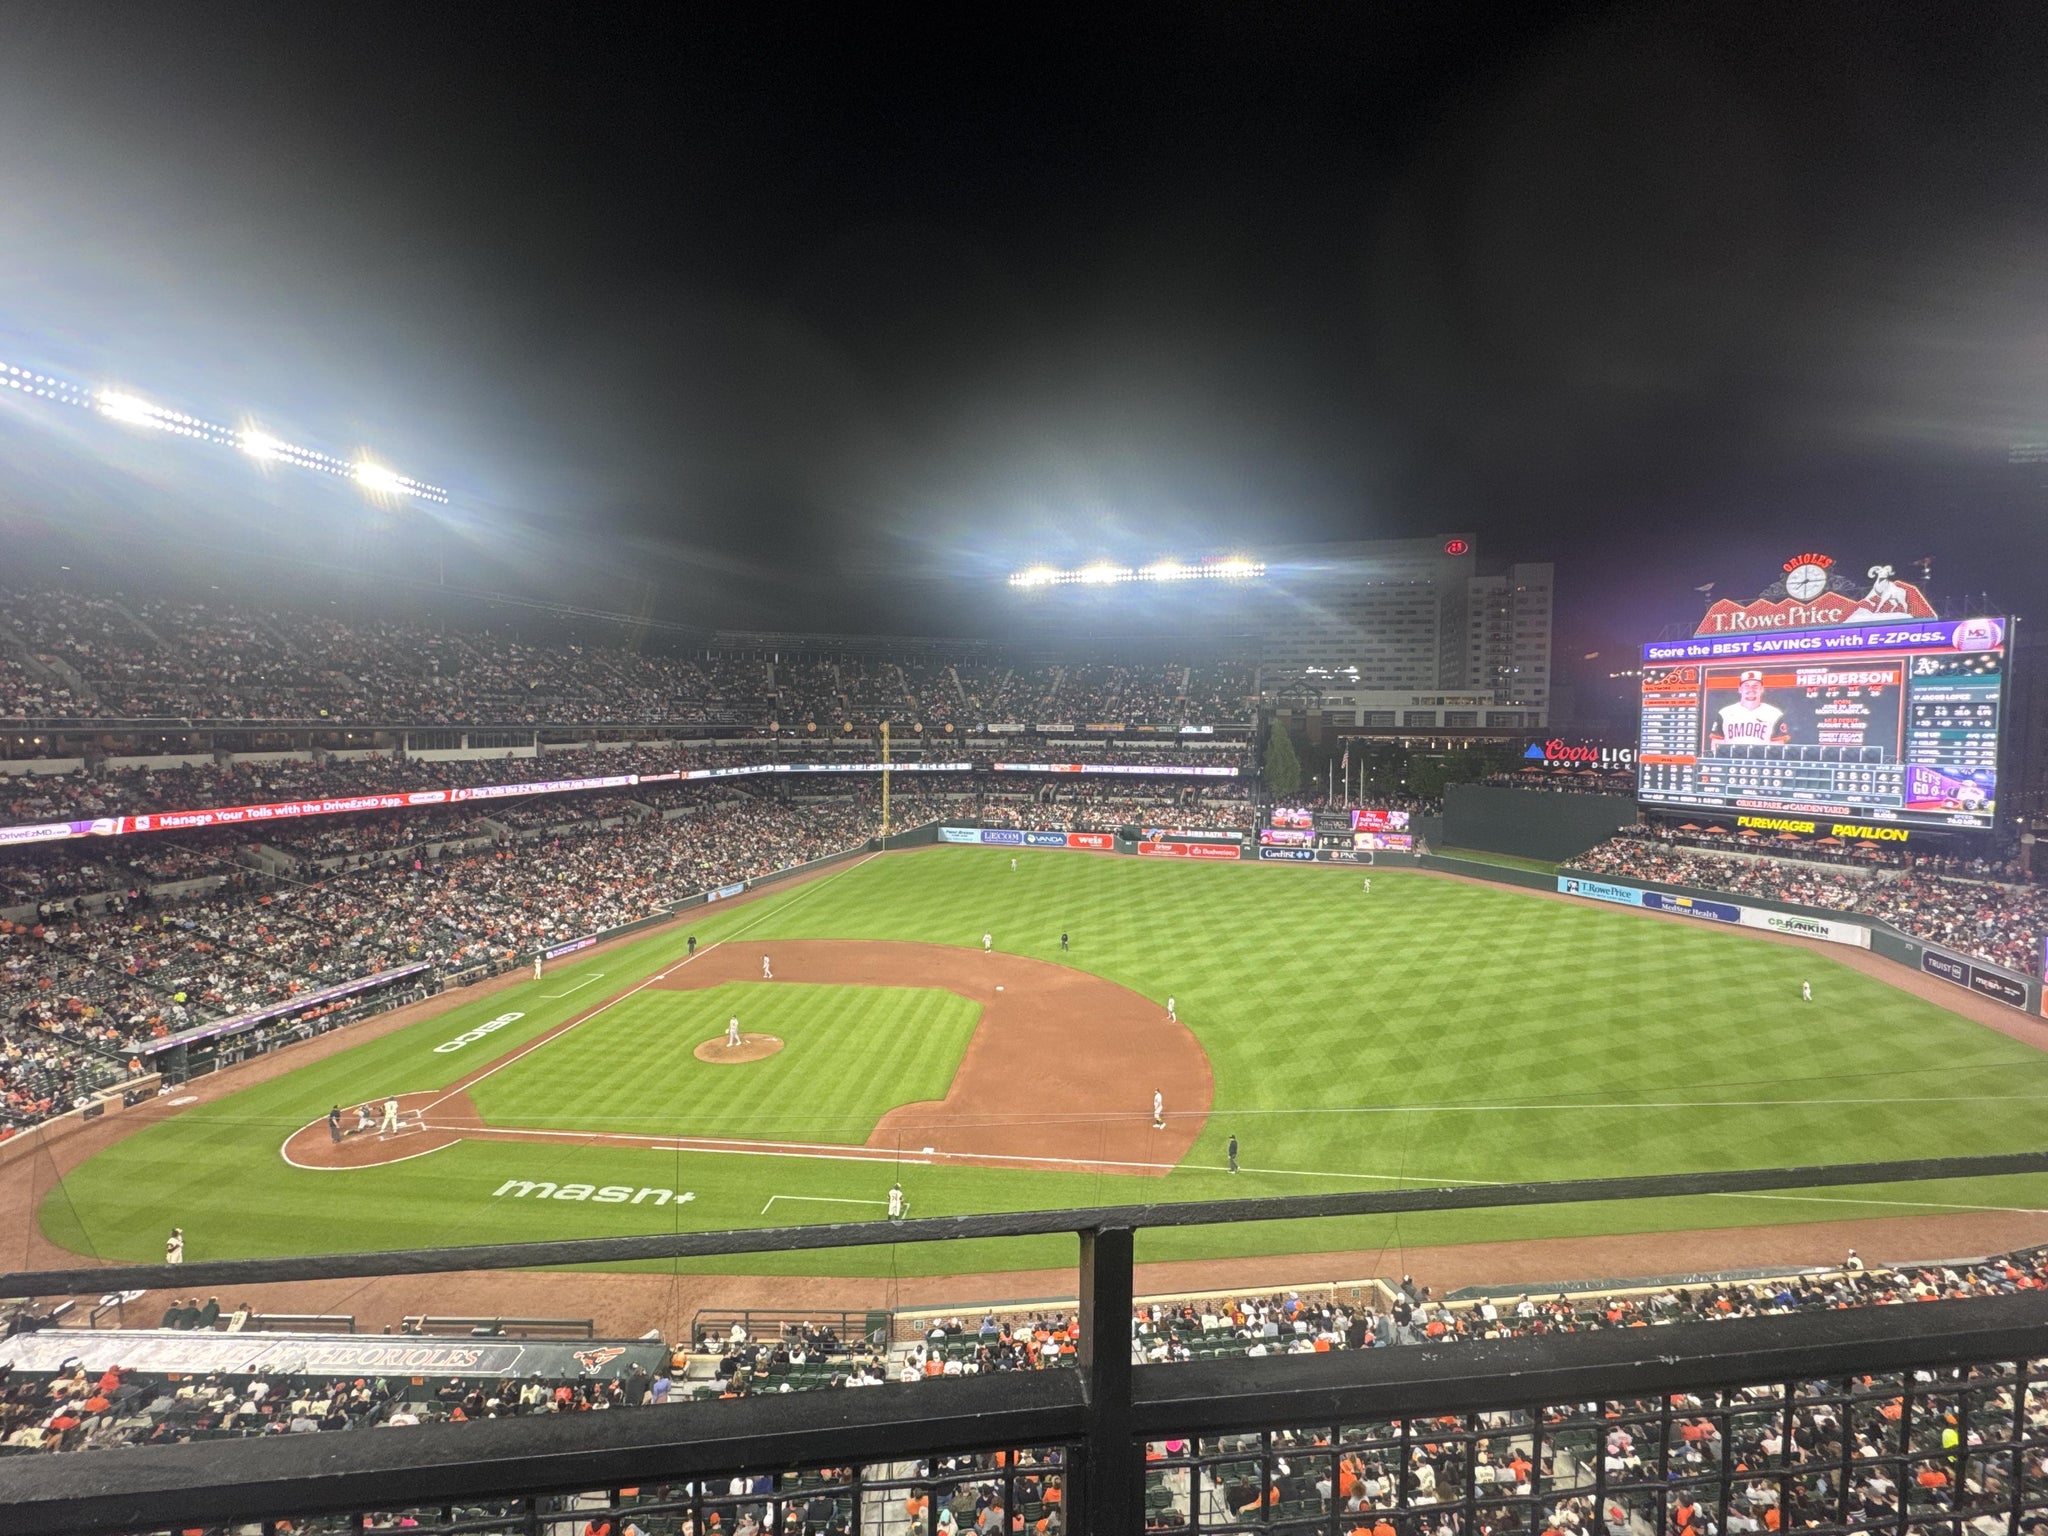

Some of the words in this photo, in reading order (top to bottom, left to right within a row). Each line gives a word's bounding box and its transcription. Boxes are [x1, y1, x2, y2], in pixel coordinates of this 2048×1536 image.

[1783, 553, 1833, 572] ORIOLES
[1788, 606, 1843, 625] Price
[1649, 647, 1685, 659] Score
[1687, 644, 1711, 656] the
[1712, 642, 1750, 655] BEST
[1752, 637, 1822, 652] SAVINGS
[1825, 634, 1864, 647] with
[1867, 631, 1947, 645] E-ZPass.
[1796, 672, 1894, 686] HENDERSON
[1727, 722, 1768, 740] BMORE
[1546, 739, 1599, 761] Coors
[1740, 767, 1747, 775] 0
[1762, 768, 1770, 776] 0
[1784, 769, 1793, 777] 0
[1837, 772, 1845, 780] 3
[1861, 773, 1871, 781] 0
[1878, 773, 1887, 782] 4
[1892, 774, 1901, 782] 2
[1915, 767, 1941, 786] LET'S
[473, 788, 488, 797] Pay
[1728, 777, 1736, 785] 0
[1773, 779, 1781, 787] 0
[1837, 782, 1844, 790] 1
[1848, 783, 1857, 791] 2
[1861, 784, 1870, 792] 0
[1878, 785, 1886, 793] 3
[1891, 786, 1900, 794] 2
[1913, 781, 1929, 795] GO
[159, 813, 213, 827] Manage
[215, 809, 244, 822] Your
[246, 807, 273, 819] Tolls
[275, 805, 301, 816] with
[302, 802, 321, 814] the
[323, 800, 379, 812] DriveEzMD
[380, 797, 404, 809] App.
[1736, 799, 1763, 808] ORIOLE
[1763, 801, 1783, 810] PARK
[1790, 803, 1823, 813] CAMDEN
[1823, 805, 1850, 815] YARDS
[984, 831, 1020, 841] LECOM
[1737, 815, 1816, 833] PUREWAGER
[1831, 824, 1910, 842] PAVILION
[1078, 835, 1103, 845] weis
[1265, 850, 1296, 859] CareFirst
[1340, 852, 1358, 860] PNC
[1611, 886, 1633, 899] Price
[1661, 902, 1686, 915] MedStar
[1692, 908, 1719, 919] Health
[1785, 920, 1830, 935] RANKIN
[1928, 957, 1952, 973] TRUIST
[433, 1012, 525, 1053] GEICO
[357, 1349, 483, 1368] ORIOLES
